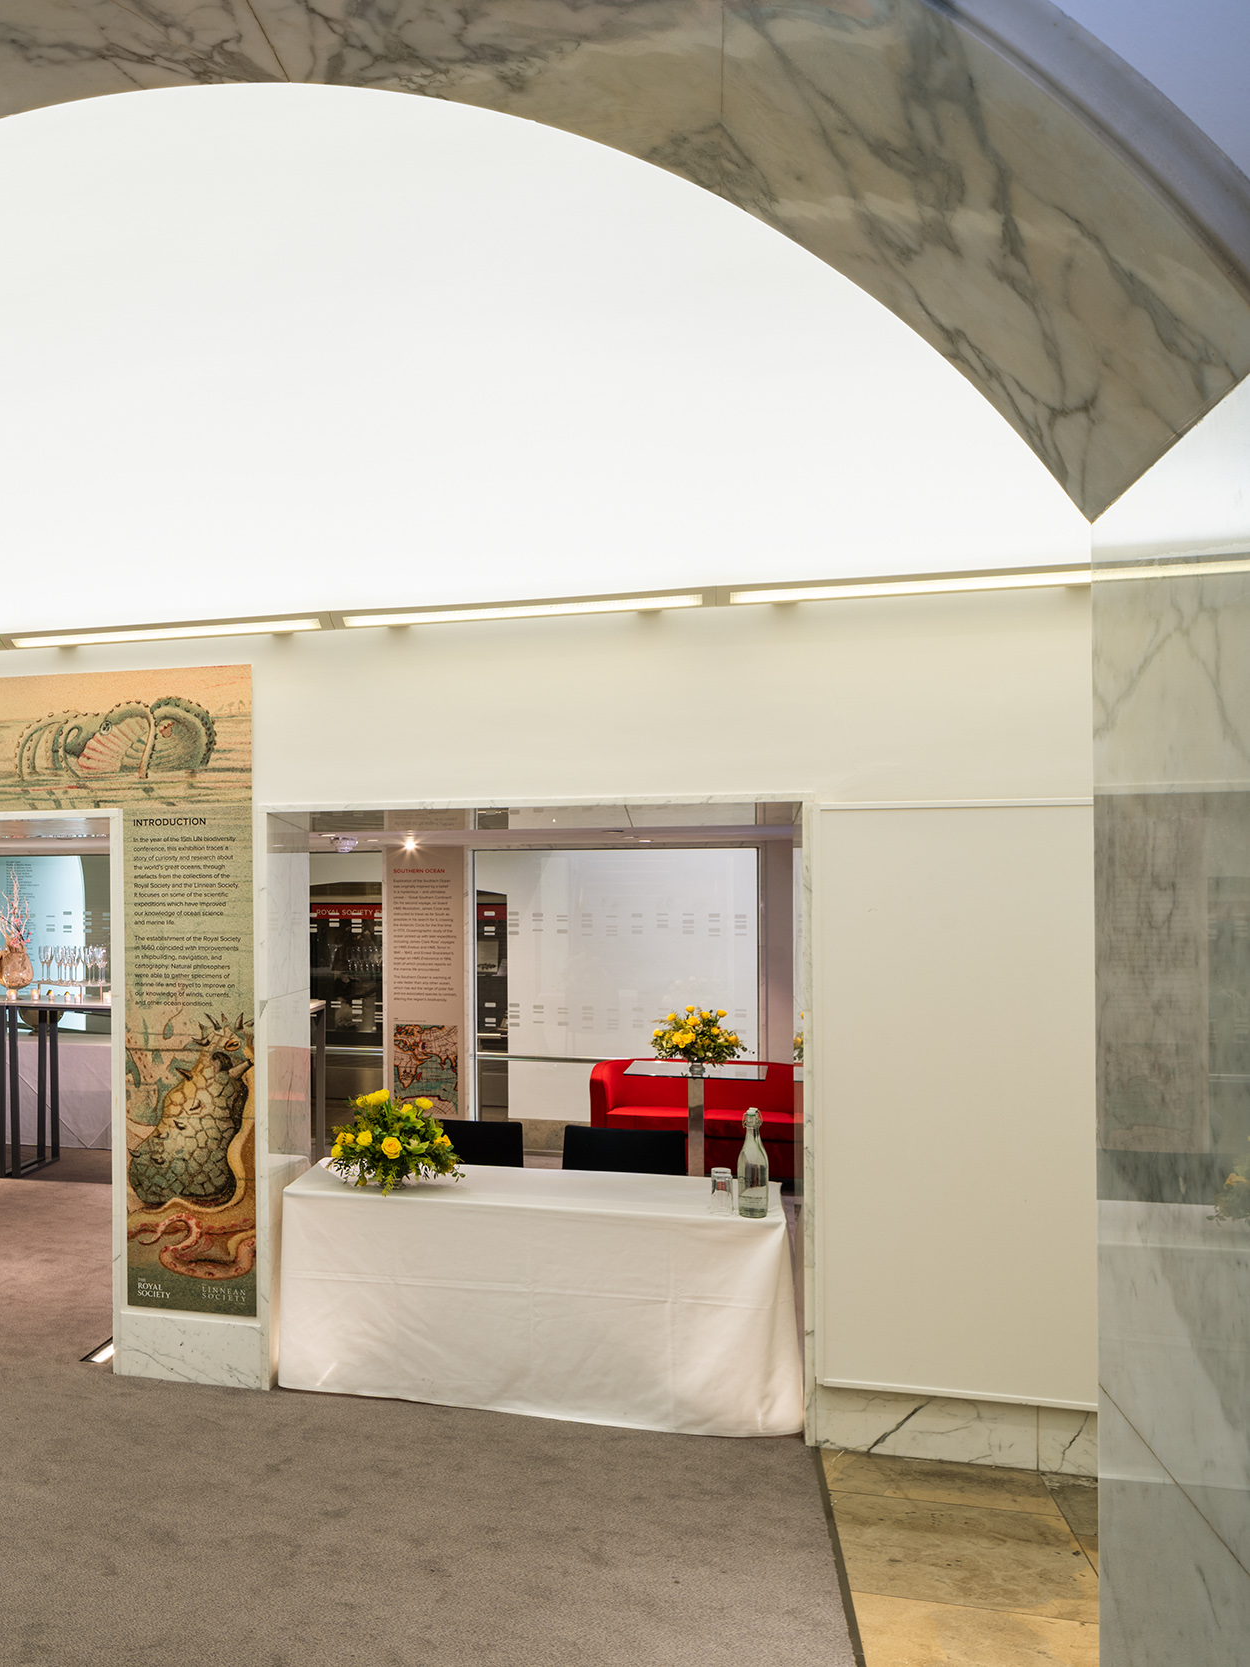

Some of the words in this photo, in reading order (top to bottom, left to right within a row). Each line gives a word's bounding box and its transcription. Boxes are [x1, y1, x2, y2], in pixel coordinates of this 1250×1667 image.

[138, 1282, 163, 1291] ROYAL
[202, 1286, 246, 1296] LINNEAN
[137, 1290, 171, 1299] SOCIETY
[202, 1293, 246, 1302] SOCIETY
